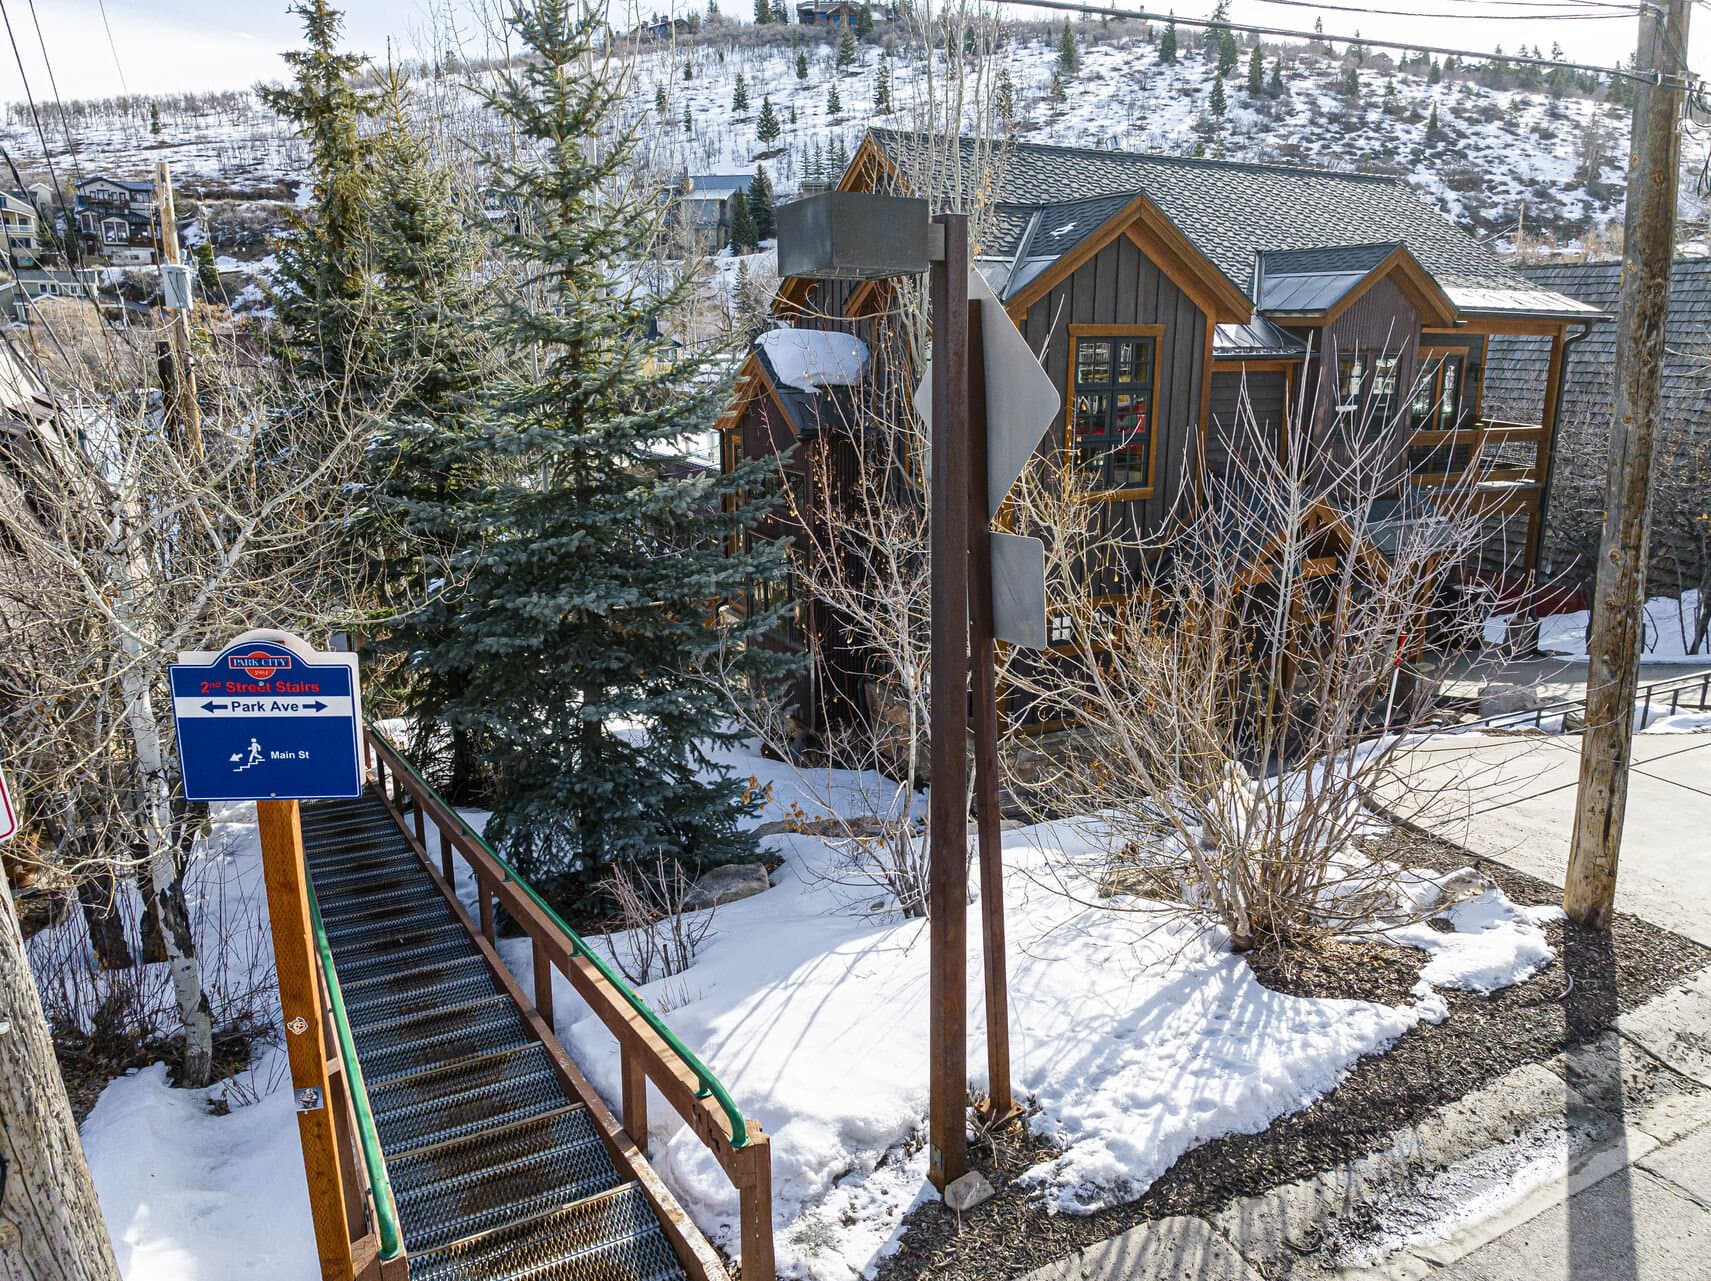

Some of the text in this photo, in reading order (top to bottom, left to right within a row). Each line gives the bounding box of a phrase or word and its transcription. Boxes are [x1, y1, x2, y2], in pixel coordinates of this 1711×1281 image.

[233, 658, 287, 666] PARK CITY
[201, 681, 320, 693] 2nd Street Stairs
[231, 701, 299, 712] Park Ave
[270, 751, 310, 759] Main St
